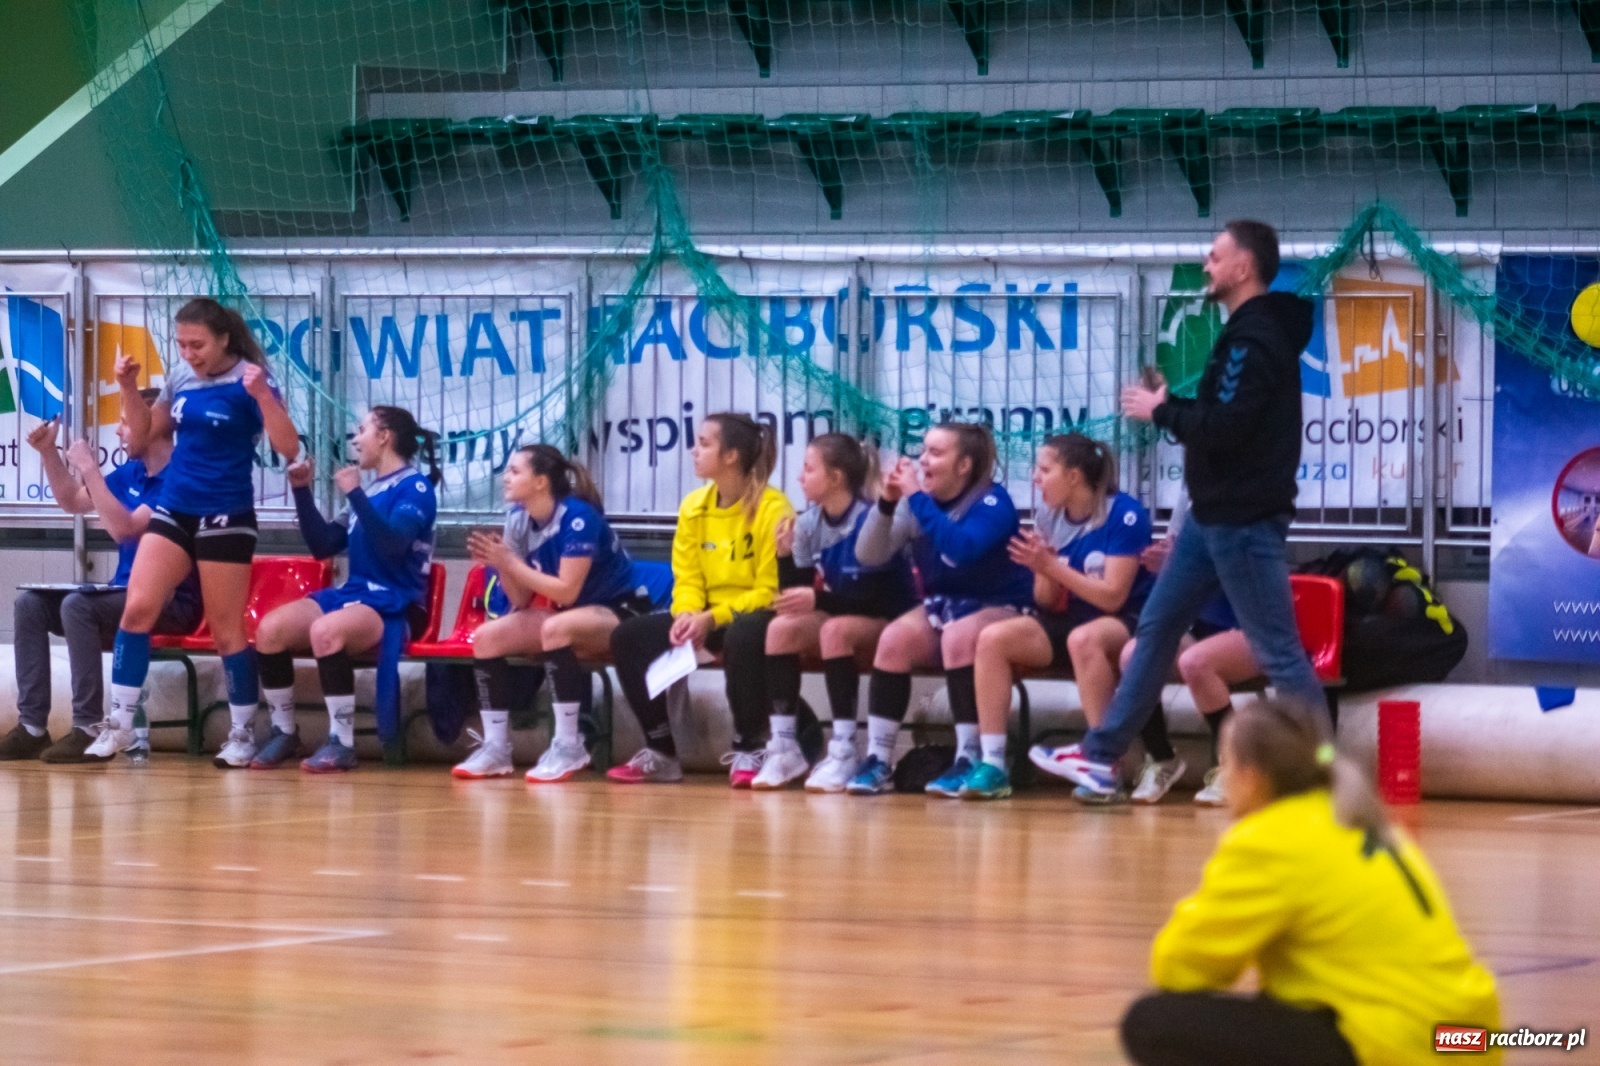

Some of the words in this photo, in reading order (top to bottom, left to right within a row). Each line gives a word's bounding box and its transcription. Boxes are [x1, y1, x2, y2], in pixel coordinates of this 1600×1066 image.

[588, 283, 1078, 365] RACIBORSKI
[1301, 406, 1464, 445] aciborski
[730, 532, 755, 561] 12
